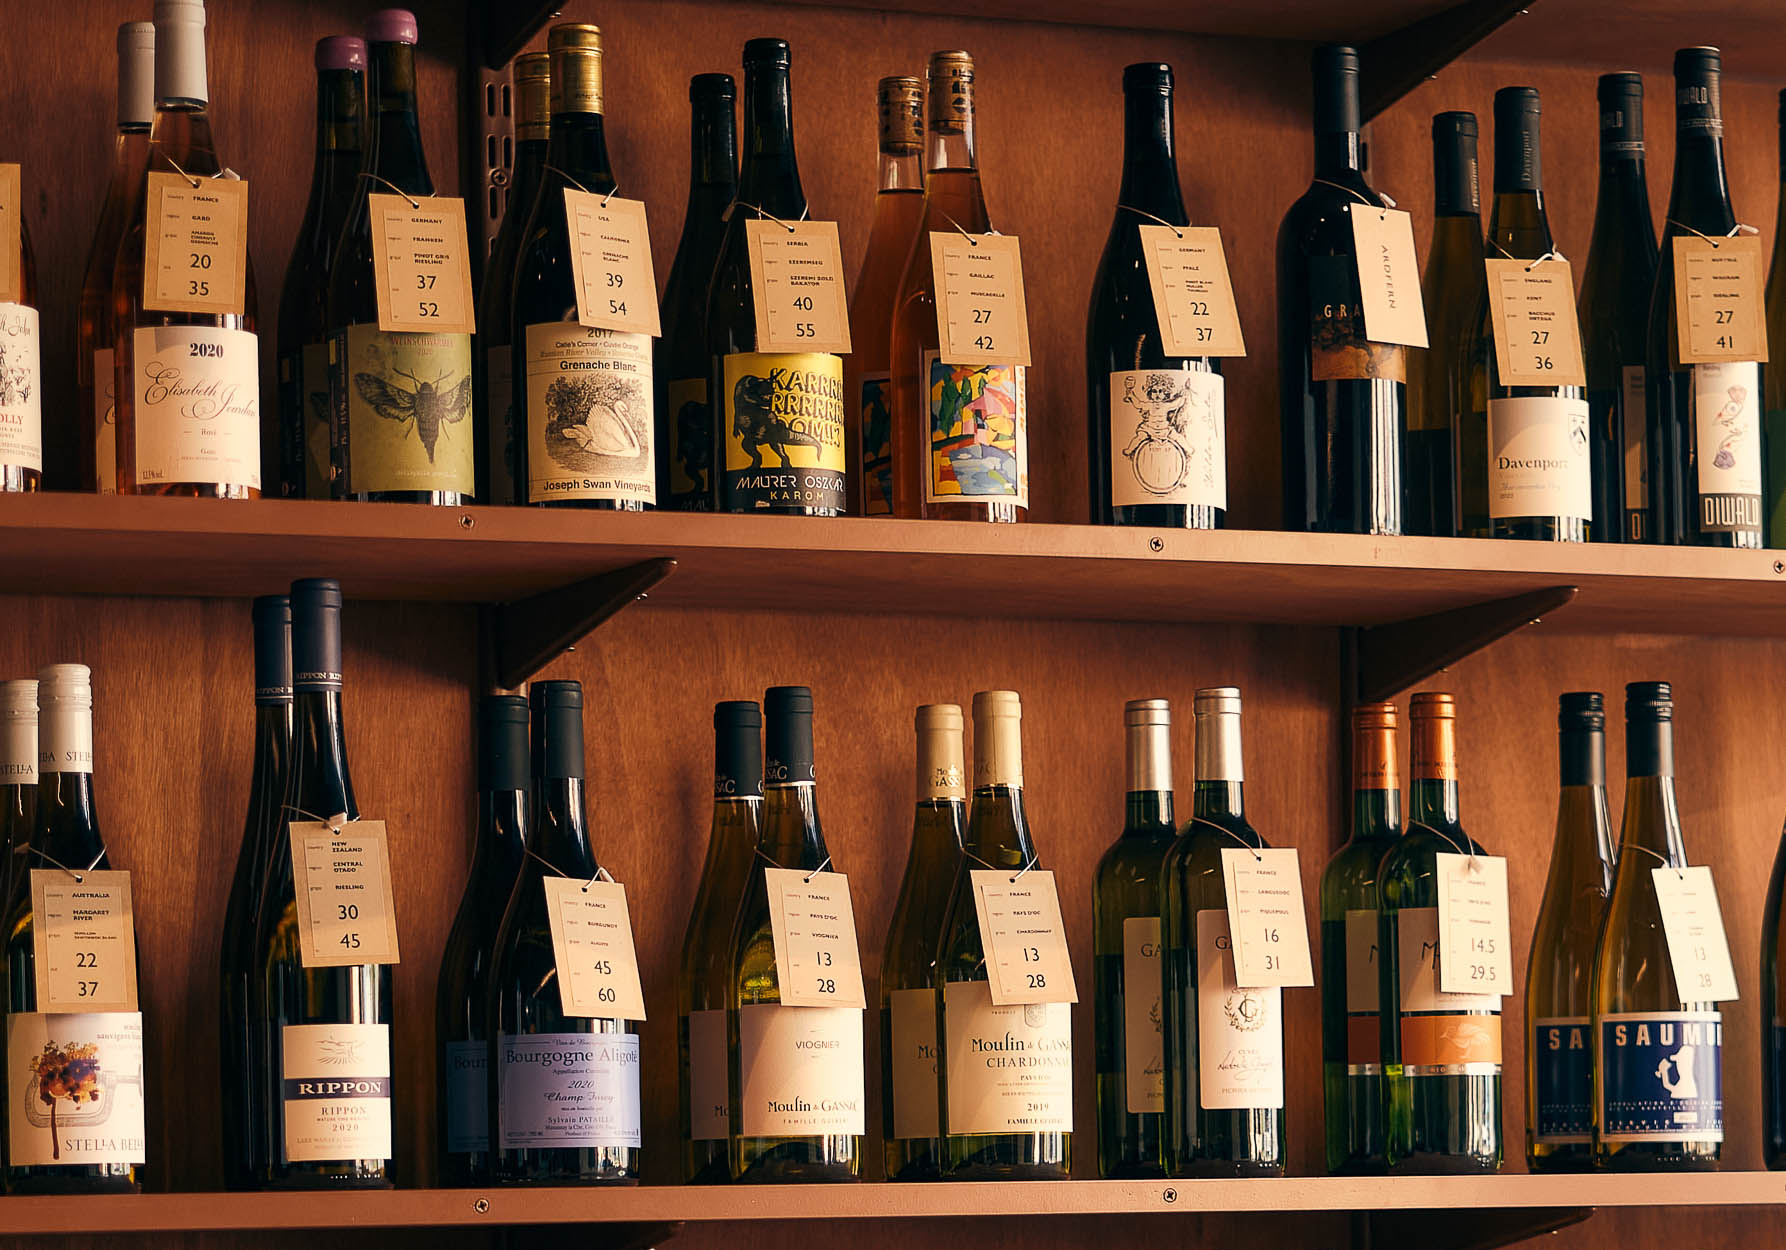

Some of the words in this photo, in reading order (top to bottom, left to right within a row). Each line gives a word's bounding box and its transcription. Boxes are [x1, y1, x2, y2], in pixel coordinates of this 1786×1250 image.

[411, 217, 443, 225] GERMANY
[190, 254, 211, 270] 20
[417, 275, 436, 290] 37
[606, 273, 623, 288] 39
[189, 281, 209, 296] 35
[419, 303, 439, 317] 52
[609, 300, 627, 315] 54
[793, 296, 813, 311] 40
[1190, 302, 1209, 316] 22
[972, 310, 992, 324] 27
[1715, 311, 1733, 324] 27
[587, 329, 614, 339] 2017
[796, 324, 815, 337] 55
[1196, 328, 1213, 341] 37
[1531, 331, 1549, 344] 27
[190, 342, 224, 358] 2020
[975, 336, 994, 350] 42
[1717, 336, 1733, 349] 41
[560, 360, 609, 371] Grenache
[614, 362, 637, 372] Blanc
[1535, 357, 1552, 370] 36
[145, 361, 217, 405] Elisabeth
[543, 480, 580, 492] Joseph
[583, 480, 611, 489] Swan
[614, 481, 650, 492] Vineyards
[736, 476, 797, 490] MAURER
[770, 492, 824, 501] KAROM
[1705, 497, 1759, 526] DIWALD
[338, 904, 359, 920] 30
[341, 933, 361, 949] 45
[1264, 929, 1279, 943] 16
[1471, 938, 1495, 954] 14.5
[1695, 946, 1706, 961] 13
[76, 952, 98, 968] 22
[816, 952, 832, 966] 13
[1023, 947, 1040, 962] 13
[594, 960, 611, 975] 45
[1265, 955, 1280, 970] 31
[1470, 965, 1496, 981] 29.5
[1699, 973, 1712, 988] 28
[817, 979, 835, 994] 28
[1026, 974, 1046, 989] 28
[78, 982, 99, 997] 37
[598, 988, 616, 1003] 60
[795, 1040, 840, 1050] VIOGNIER
[972, 1032, 1025, 1052] Moulin
[506, 1049, 594, 1068] Bourgogne
[599, 1050, 638, 1065] Aligoté
[300, 1080, 382, 1095] RIPPON
[568, 1080, 595, 1089] 2020
[321, 1106, 368, 1116] RIPPON
[768, 1095, 811, 1113] Moulin
[1027, 1103, 1049, 1111] 2019
[548, 1116, 575, 1124] Sylvain
[332, 1124, 359, 1132] 2020
[65, 1137, 117, 1153] STELLA
